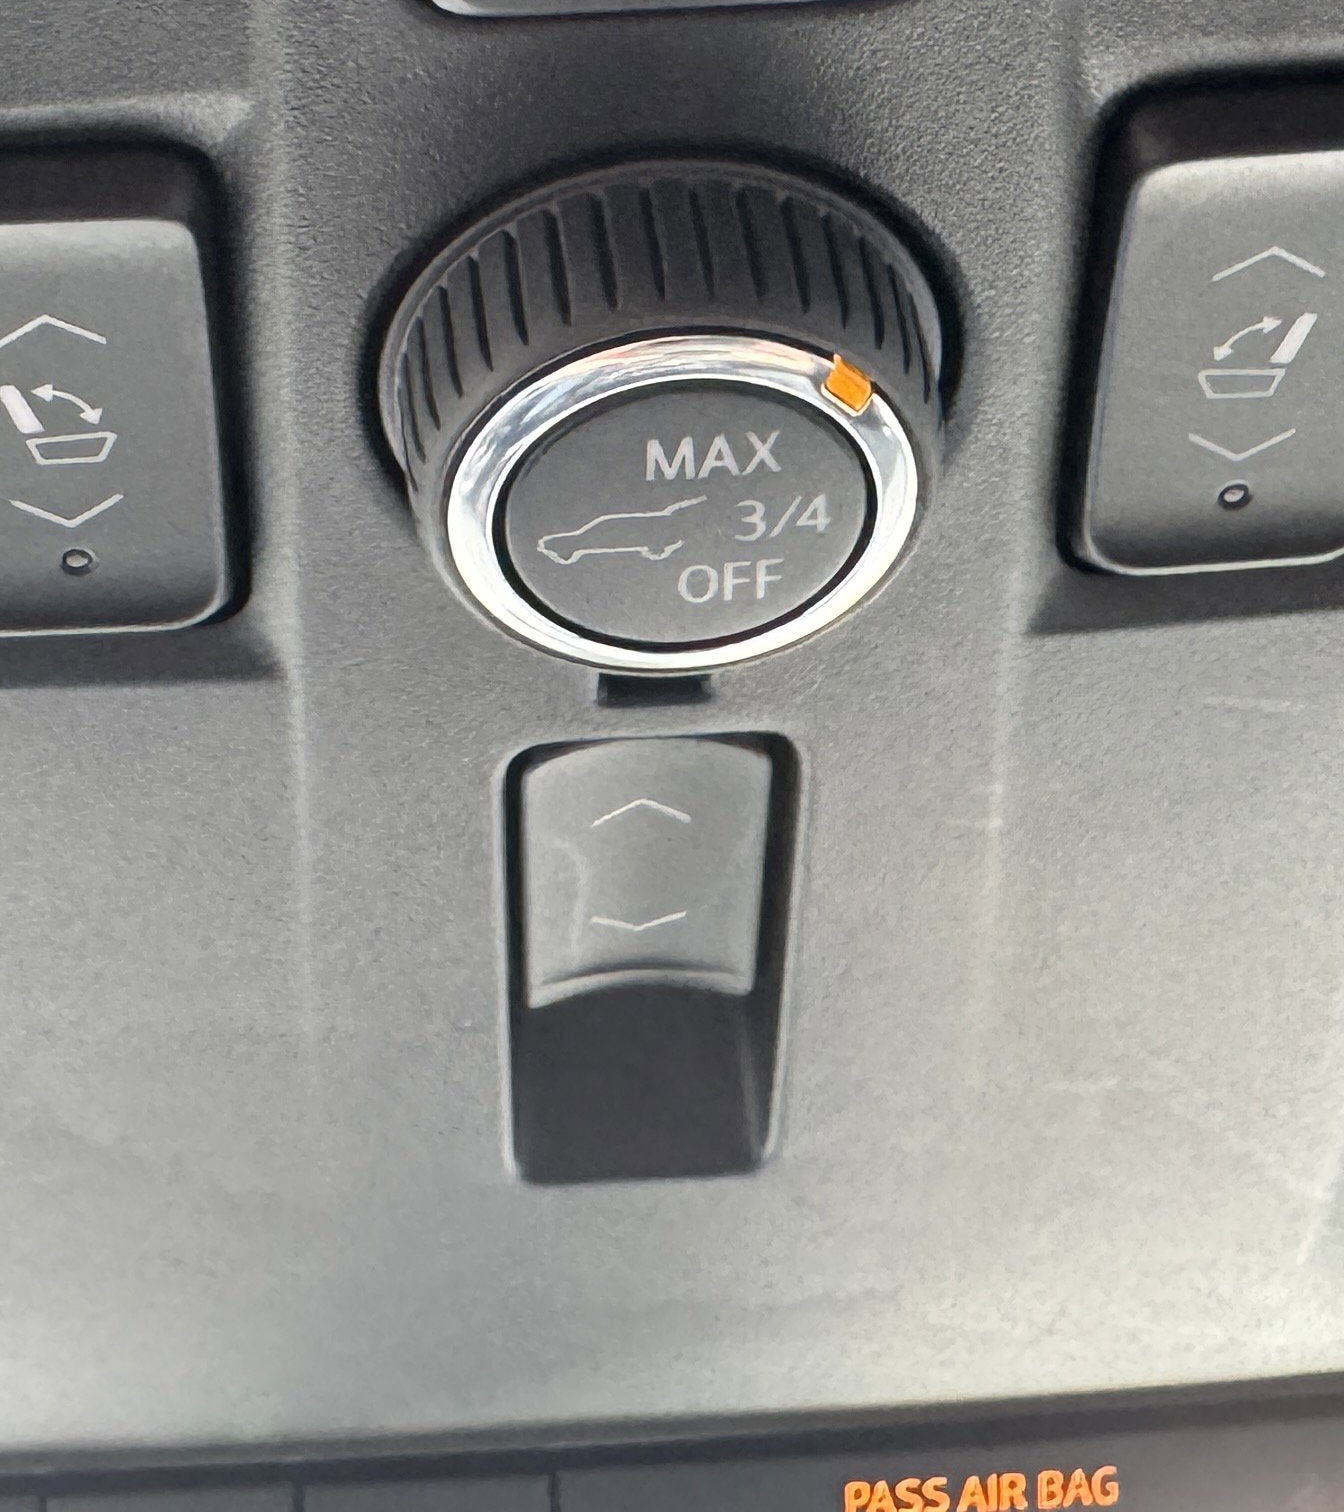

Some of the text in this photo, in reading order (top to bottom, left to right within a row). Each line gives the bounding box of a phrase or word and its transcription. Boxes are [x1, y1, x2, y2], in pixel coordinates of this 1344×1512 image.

[644, 430, 782, 482] MAX
[733, 493, 832, 542] 3/4
[677, 558, 785, 604] OFF
[843, 1464, 1120, 1512] PASS AIR BAG
